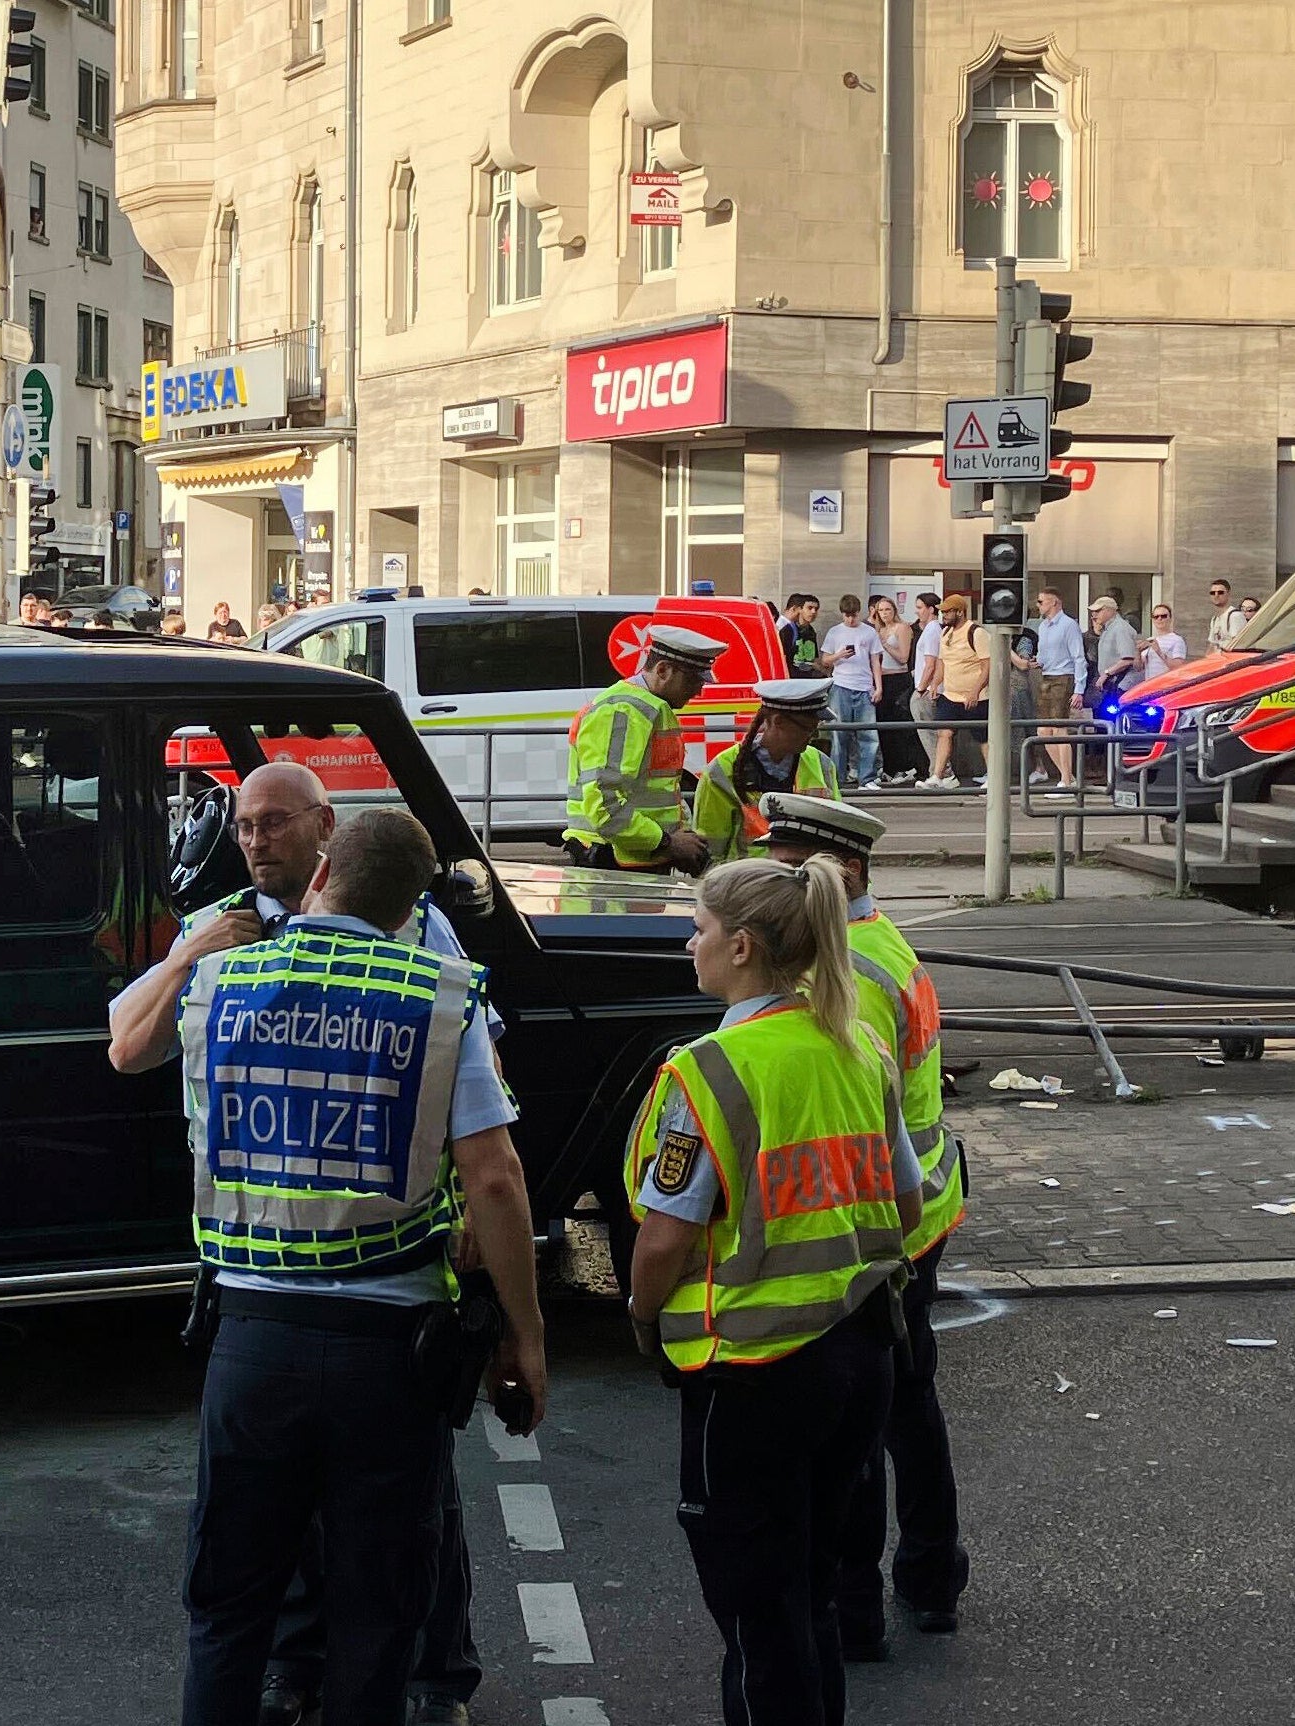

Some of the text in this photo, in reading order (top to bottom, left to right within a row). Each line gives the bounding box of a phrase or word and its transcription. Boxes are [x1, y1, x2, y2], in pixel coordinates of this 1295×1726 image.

[648, 199, 679, 208] MAILE
[22, 387, 49, 457] mink
[163, 366, 247, 416] EDEKA
[591, 354, 696, 426] tipico
[954, 453, 1040, 472] hat Vorrang
[216, 998, 417, 1070] Einsatzleitung
[221, 1091, 391, 1156] POLIZEI
